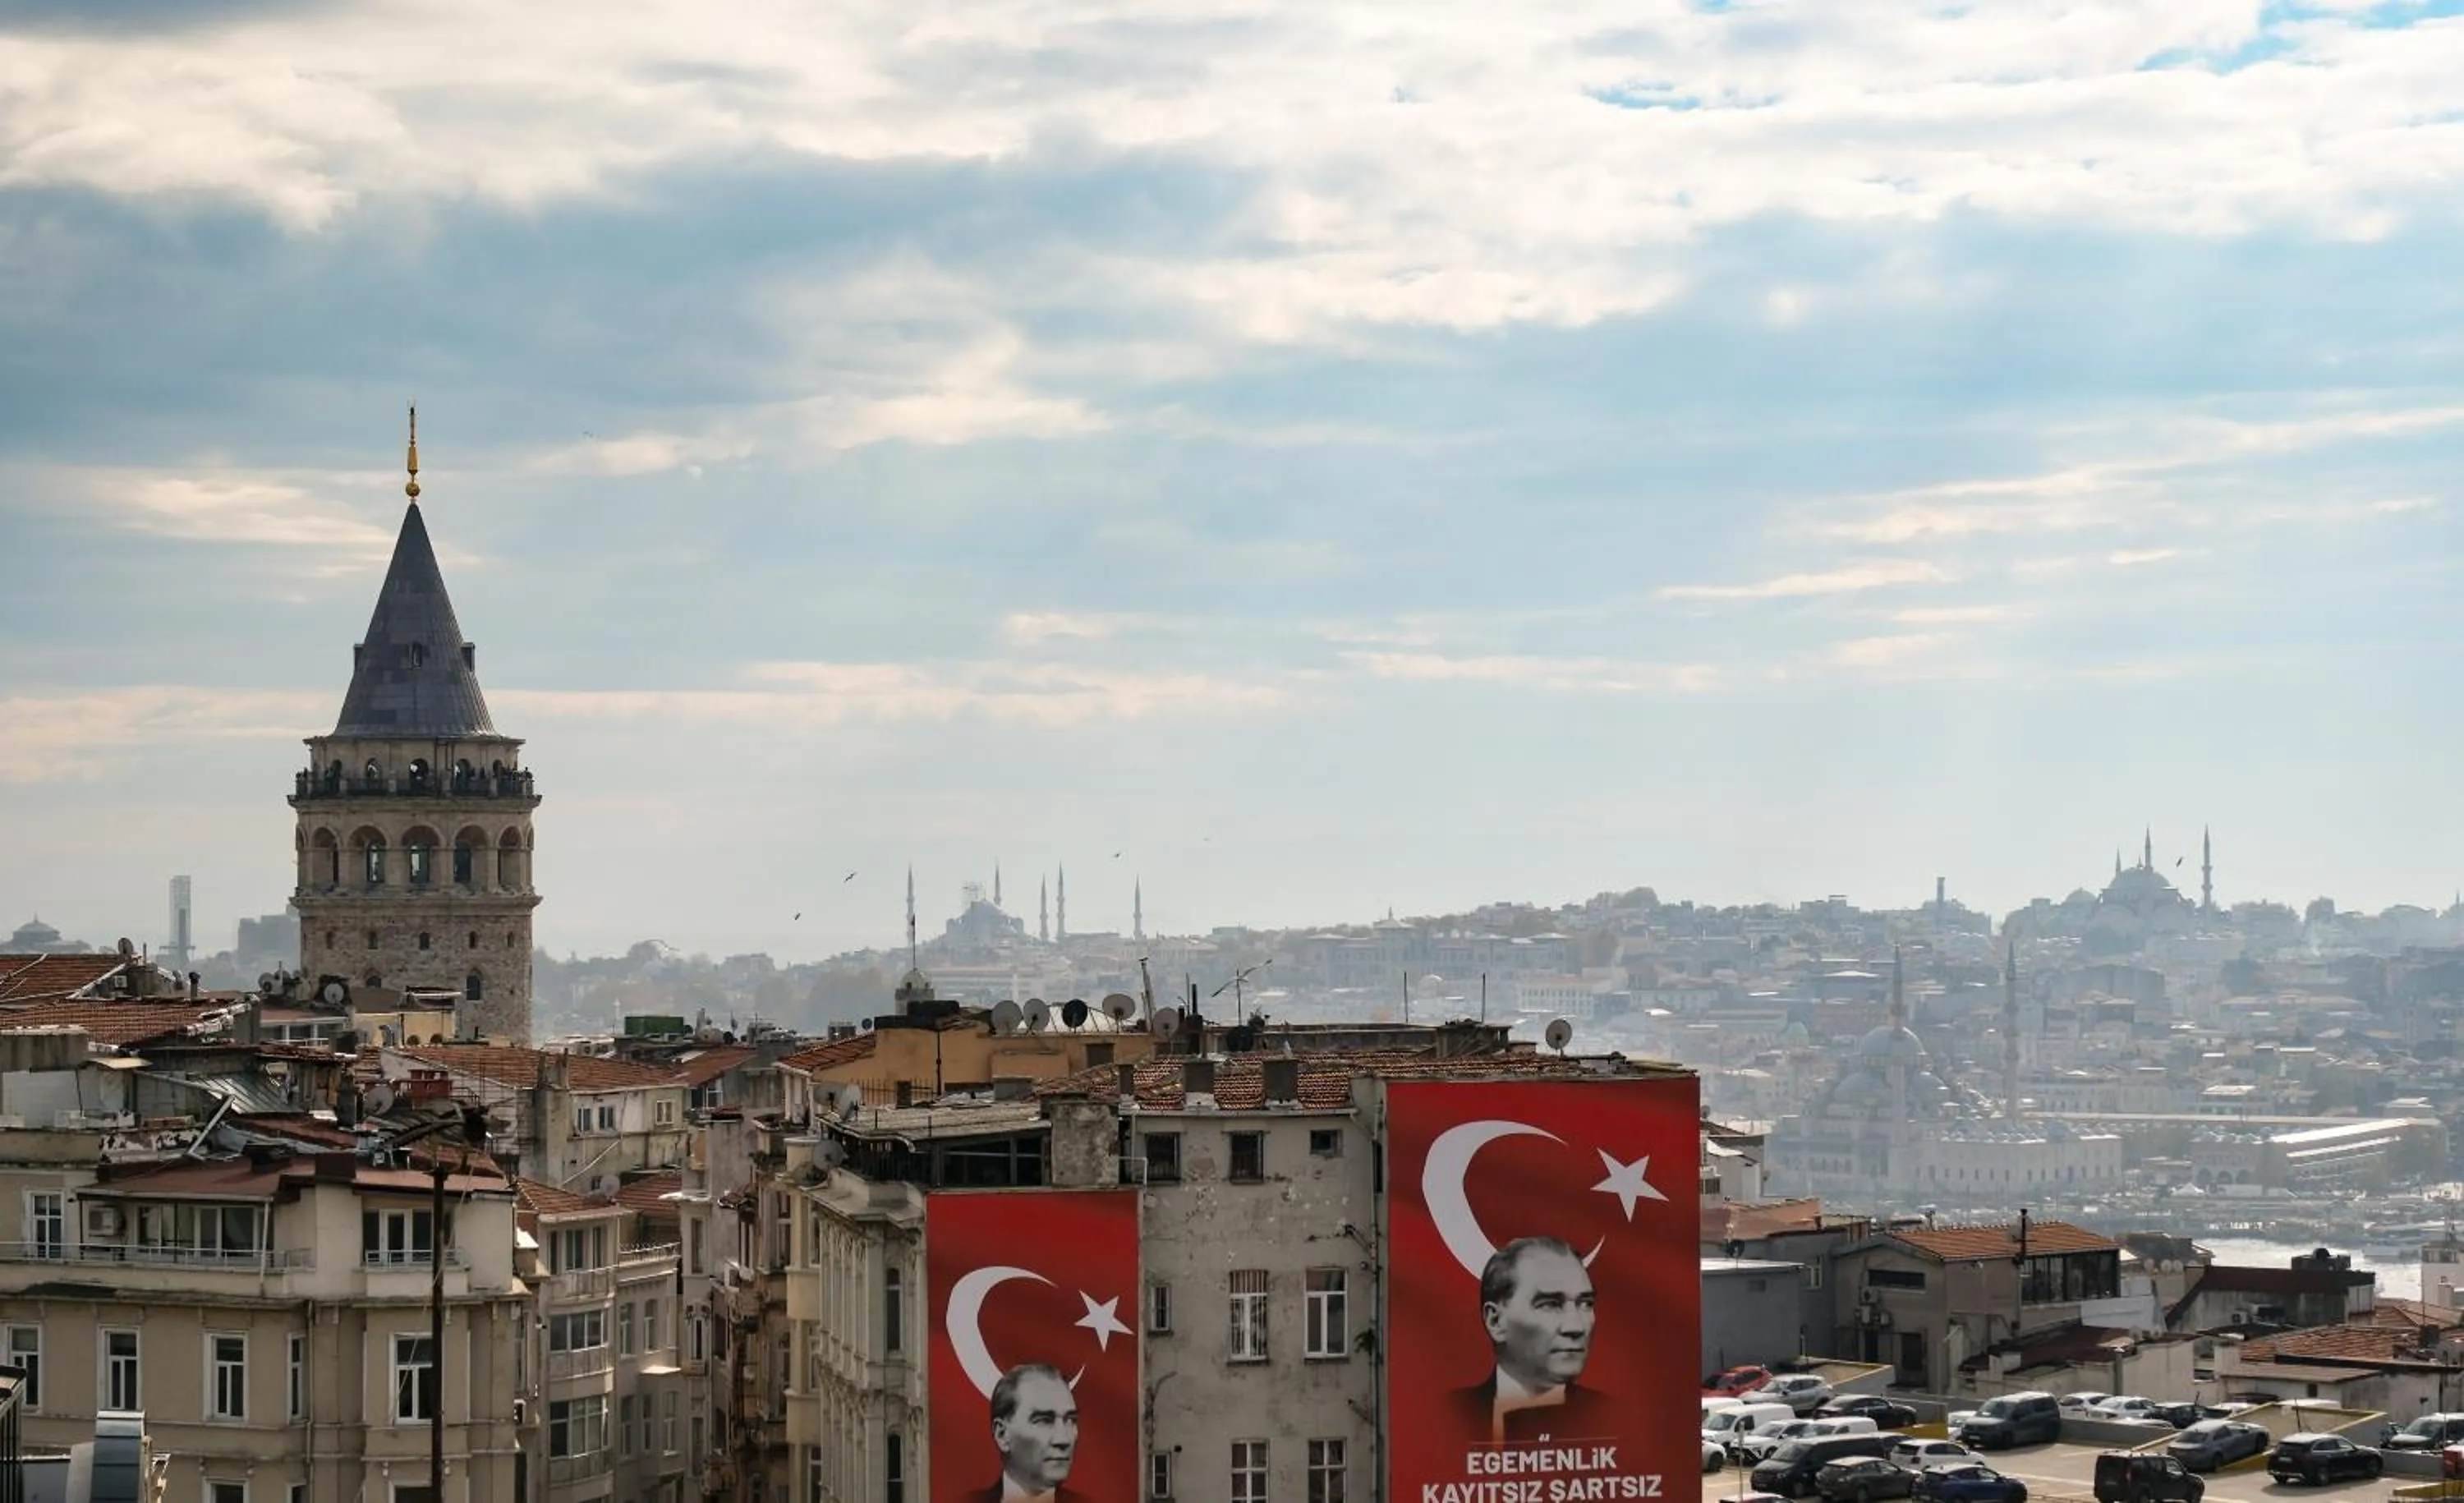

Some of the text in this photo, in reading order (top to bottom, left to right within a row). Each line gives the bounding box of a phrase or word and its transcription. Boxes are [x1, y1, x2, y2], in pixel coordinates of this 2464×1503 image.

[1467, 1447, 1617, 1474] EGEMENLİK
[1422, 1475, 1662, 1503] KAYITSIZ ŞARTSIZ
